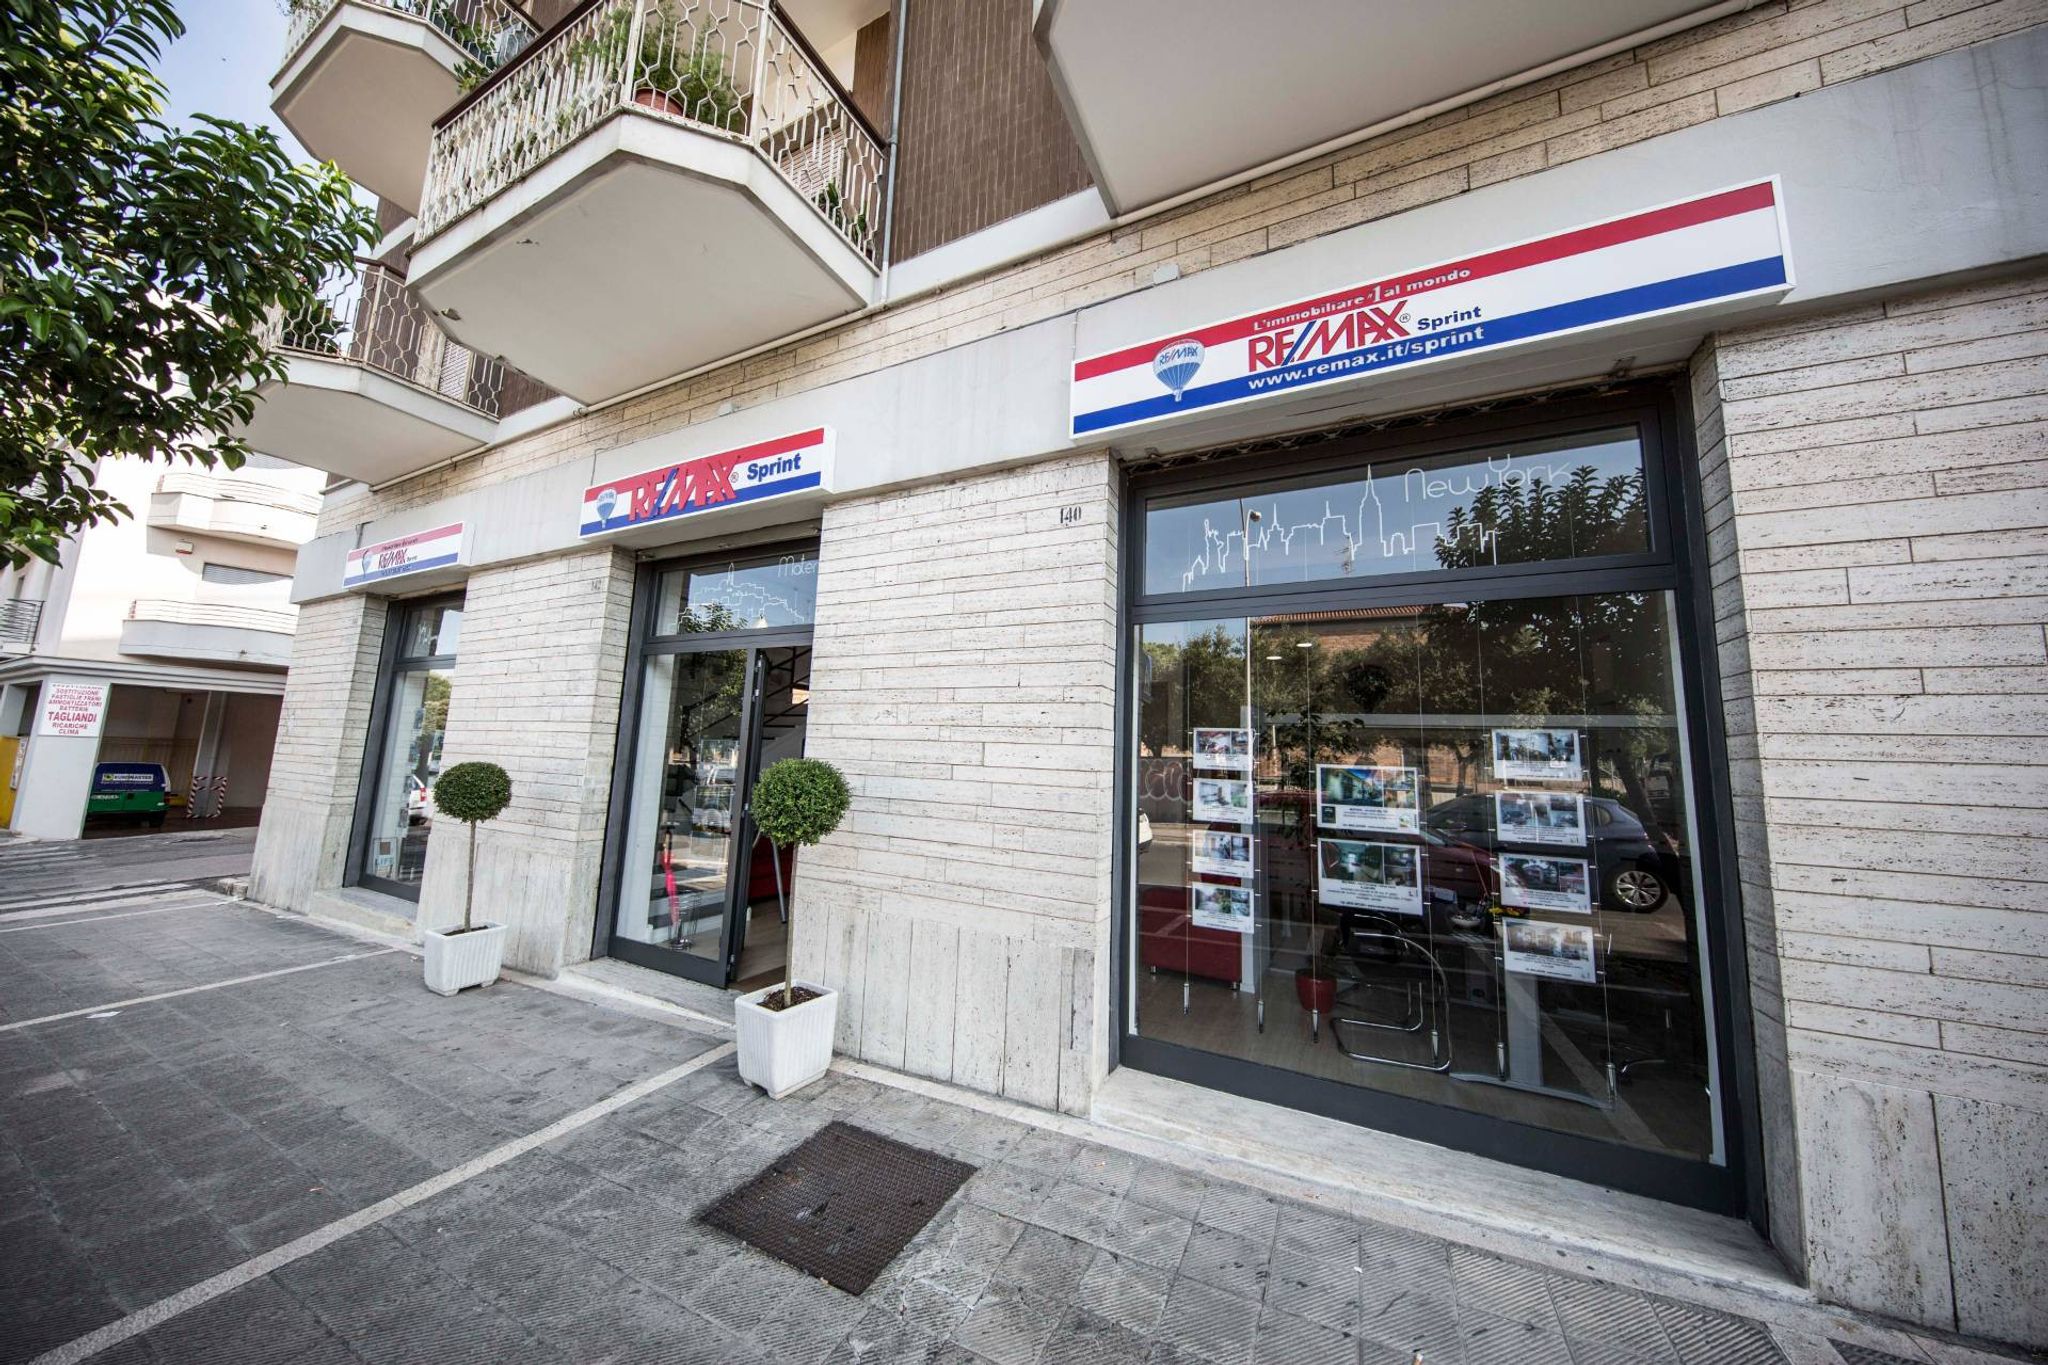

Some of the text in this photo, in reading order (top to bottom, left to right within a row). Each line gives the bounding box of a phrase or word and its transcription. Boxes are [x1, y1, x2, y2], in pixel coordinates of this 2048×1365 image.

[1253, 296, 1365, 331] L'immobiliare
[1386, 284, 1400, 298] al
[1406, 268, 1472, 292] mondo
[1248, 299, 1482, 373] RE/MAX Sprint
[1159, 345, 1199, 366] RE/MAX
[1248, 325, 1485, 390] www.remax.it/sprint
[746, 452, 802, 482] Sprint
[1060, 506, 1082, 524] 140
[48, 711, 97, 723] TAGLIANDI
[52, 721, 89, 730] RICARICHE
